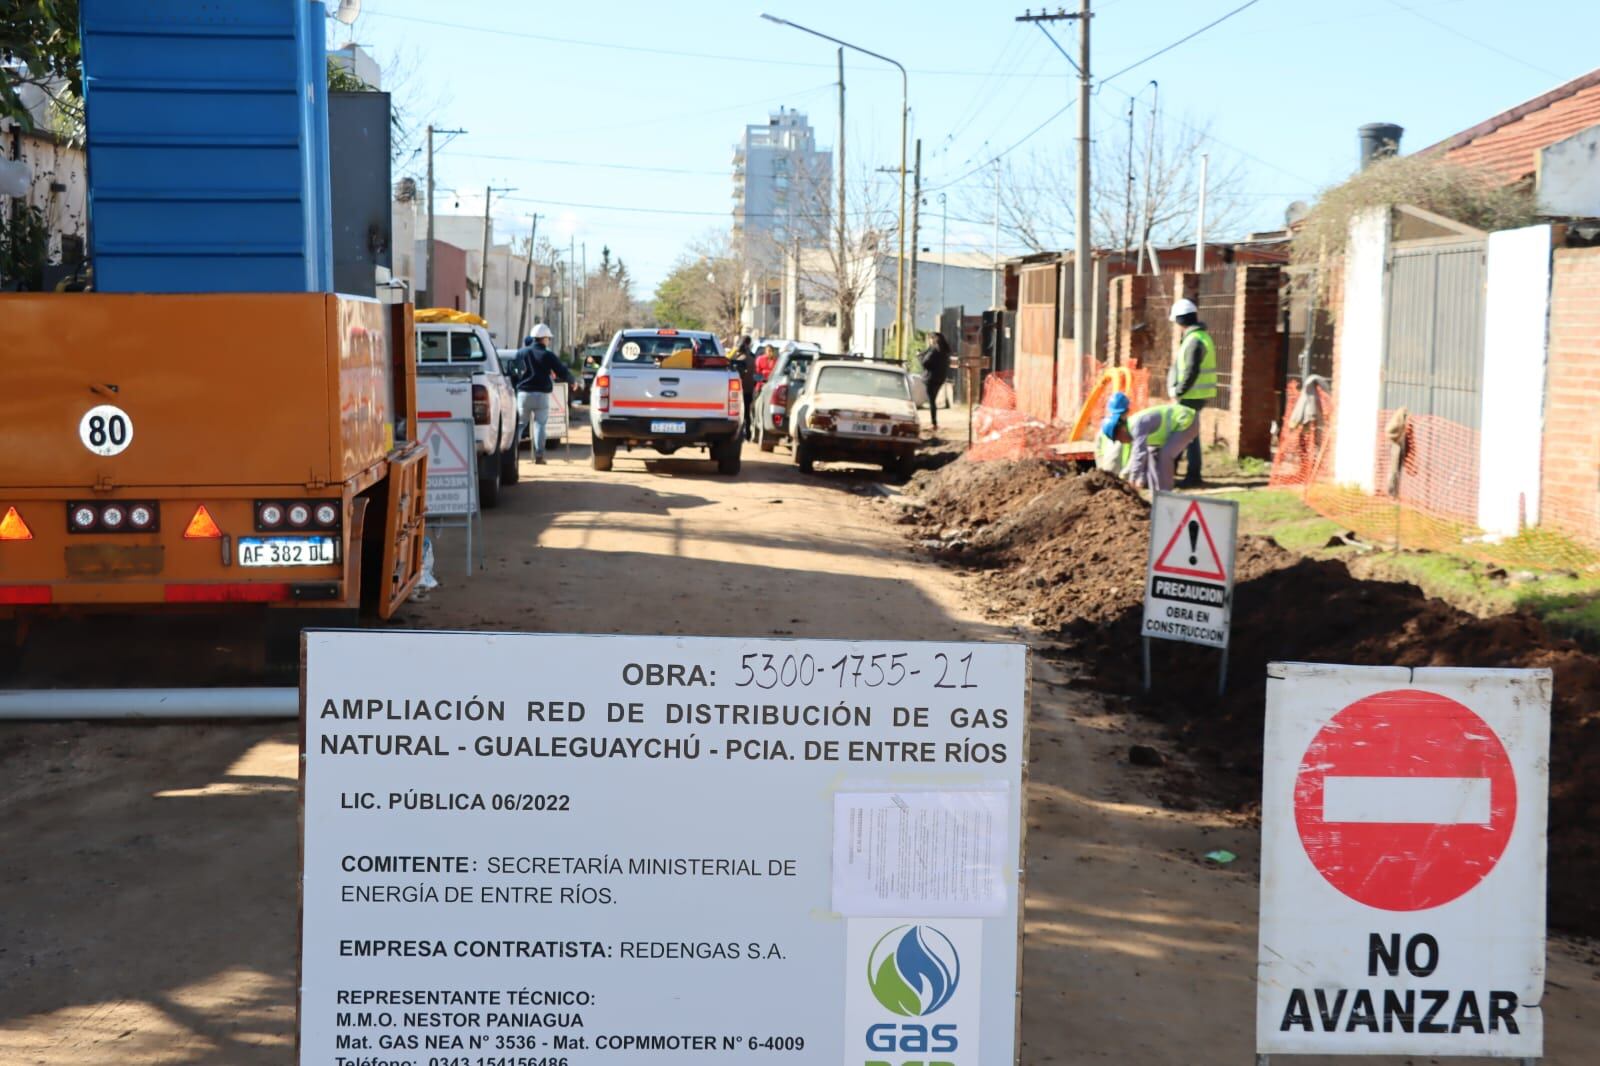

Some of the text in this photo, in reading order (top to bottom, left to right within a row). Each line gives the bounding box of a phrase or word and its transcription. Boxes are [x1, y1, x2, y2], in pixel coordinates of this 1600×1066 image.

[89, 415, 126, 446] 80
[243, 544, 329, 563] AF 382 DL
[1155, 580, 1224, 603] PRECAUCION
[1166, 606, 1209, 622] OBRA EN
[1146, 619, 1224, 641] CONSTRUCCION
[623, 663, 715, 686] OBRA:
[320, 695, 1007, 728] AMPLIACIÓN RED DE DISTRIBUCIÓN DE GAS
[321, 735, 449, 755] NATURAL
[475, 733, 699, 759] GUALEGUAYCHÚ
[727, 740, 794, 760] PCIA.
[805, 741, 839, 760] DE
[849, 741, 935, 762] ENTRE
[945, 738, 1007, 763] RÍOS
[342, 789, 569, 811] LIC. PÚBLICA 06/2022
[342, 854, 796, 876] COMITENTE: SECRETARÍA MINISTERIAL DE
[342, 883, 616, 904] ENERGÍA DE ENTRE RÍOS.
[340, 940, 785, 959] EMPRESA CONTRATISTA: REDENGAS S.A.
[1368, 933, 1439, 977] NO
[337, 987, 595, 1005] REPRESENTANTE TÉCNICO:
[337, 1013, 583, 1027] M.M.O. NESTOR PANIAGUA
[1280, 988, 1520, 1034] AVANZAR
[336, 1035, 372, 1049] Mat.
[379, 1035, 418, 1049] GAS
[426, 1035, 464, 1049] NEA
[496, 1035, 535, 1049] 3536
[554, 1035, 589, 1049] Mat.
[596, 1035, 716, 1050] COPMMOTER
[749, 1037, 804, 1050] 6-4009
